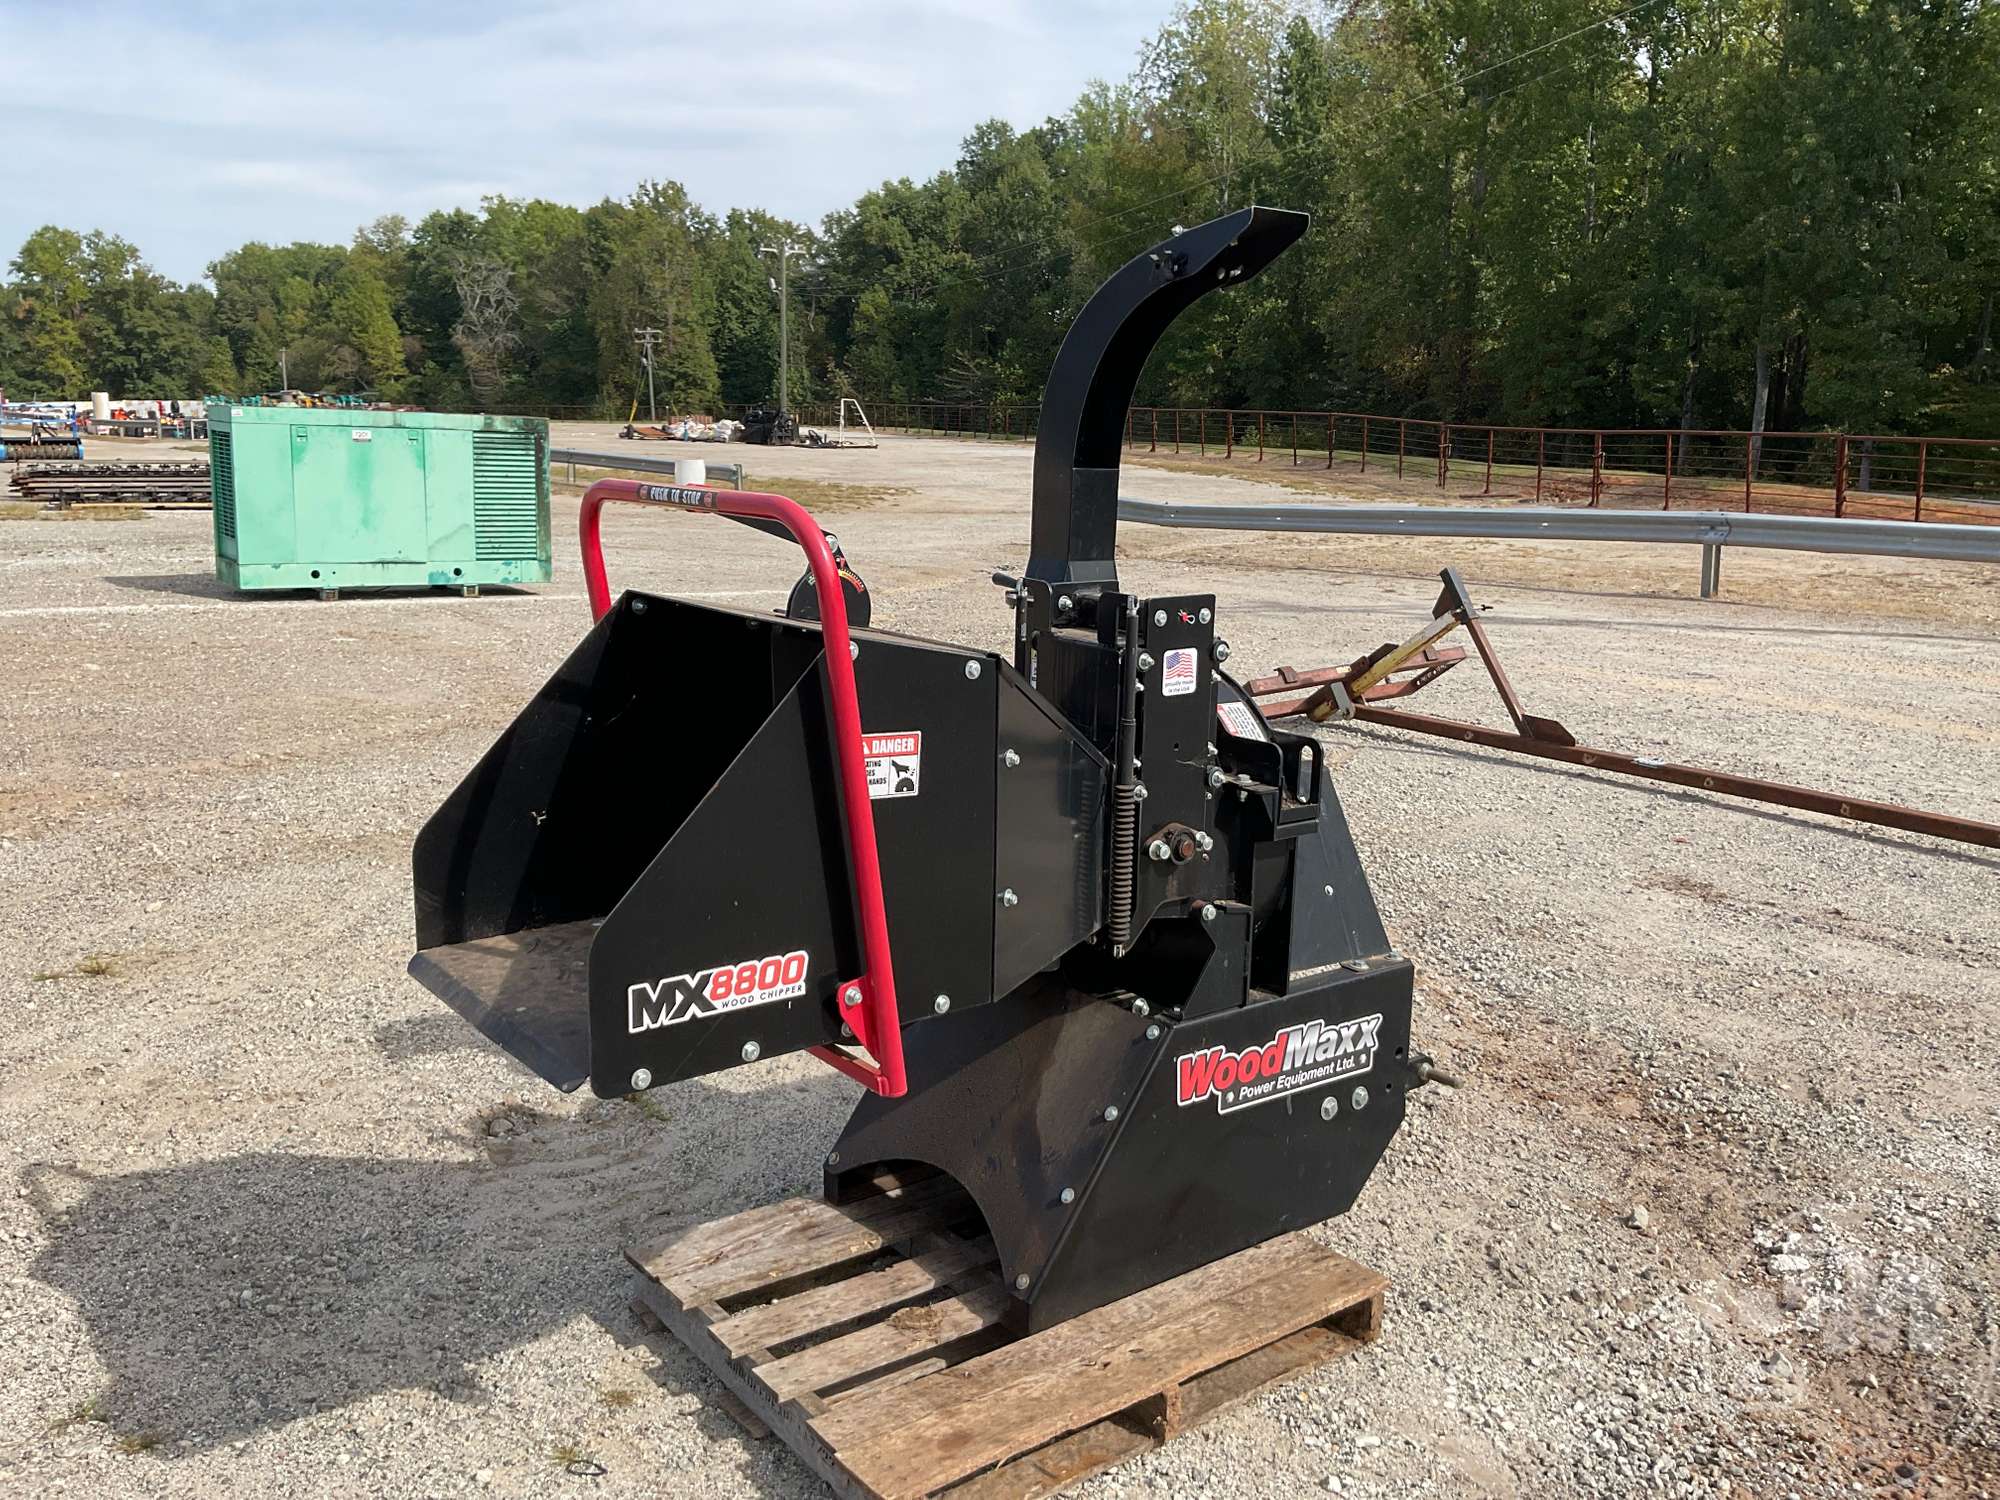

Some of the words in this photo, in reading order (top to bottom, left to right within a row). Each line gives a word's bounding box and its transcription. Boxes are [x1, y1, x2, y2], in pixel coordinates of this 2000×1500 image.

[650, 486, 670, 501] PUSH
[671, 489, 680, 503] TO
[682, 490, 701, 505] STOP
[872, 738, 914, 754] DANGER
[869, 777, 887, 785] HANDS
[630, 952, 807, 1031] MX8800
[721, 995, 755, 1009] WOOD
[759, 984, 803, 1000] CHIPPER
[1178, 1015, 1382, 1103] WoodMaxx
[1238, 1080, 1276, 1101] Power
[1276, 1065, 1335, 1090] Equipment
[1335, 1055, 1356, 1076] Ltd.
